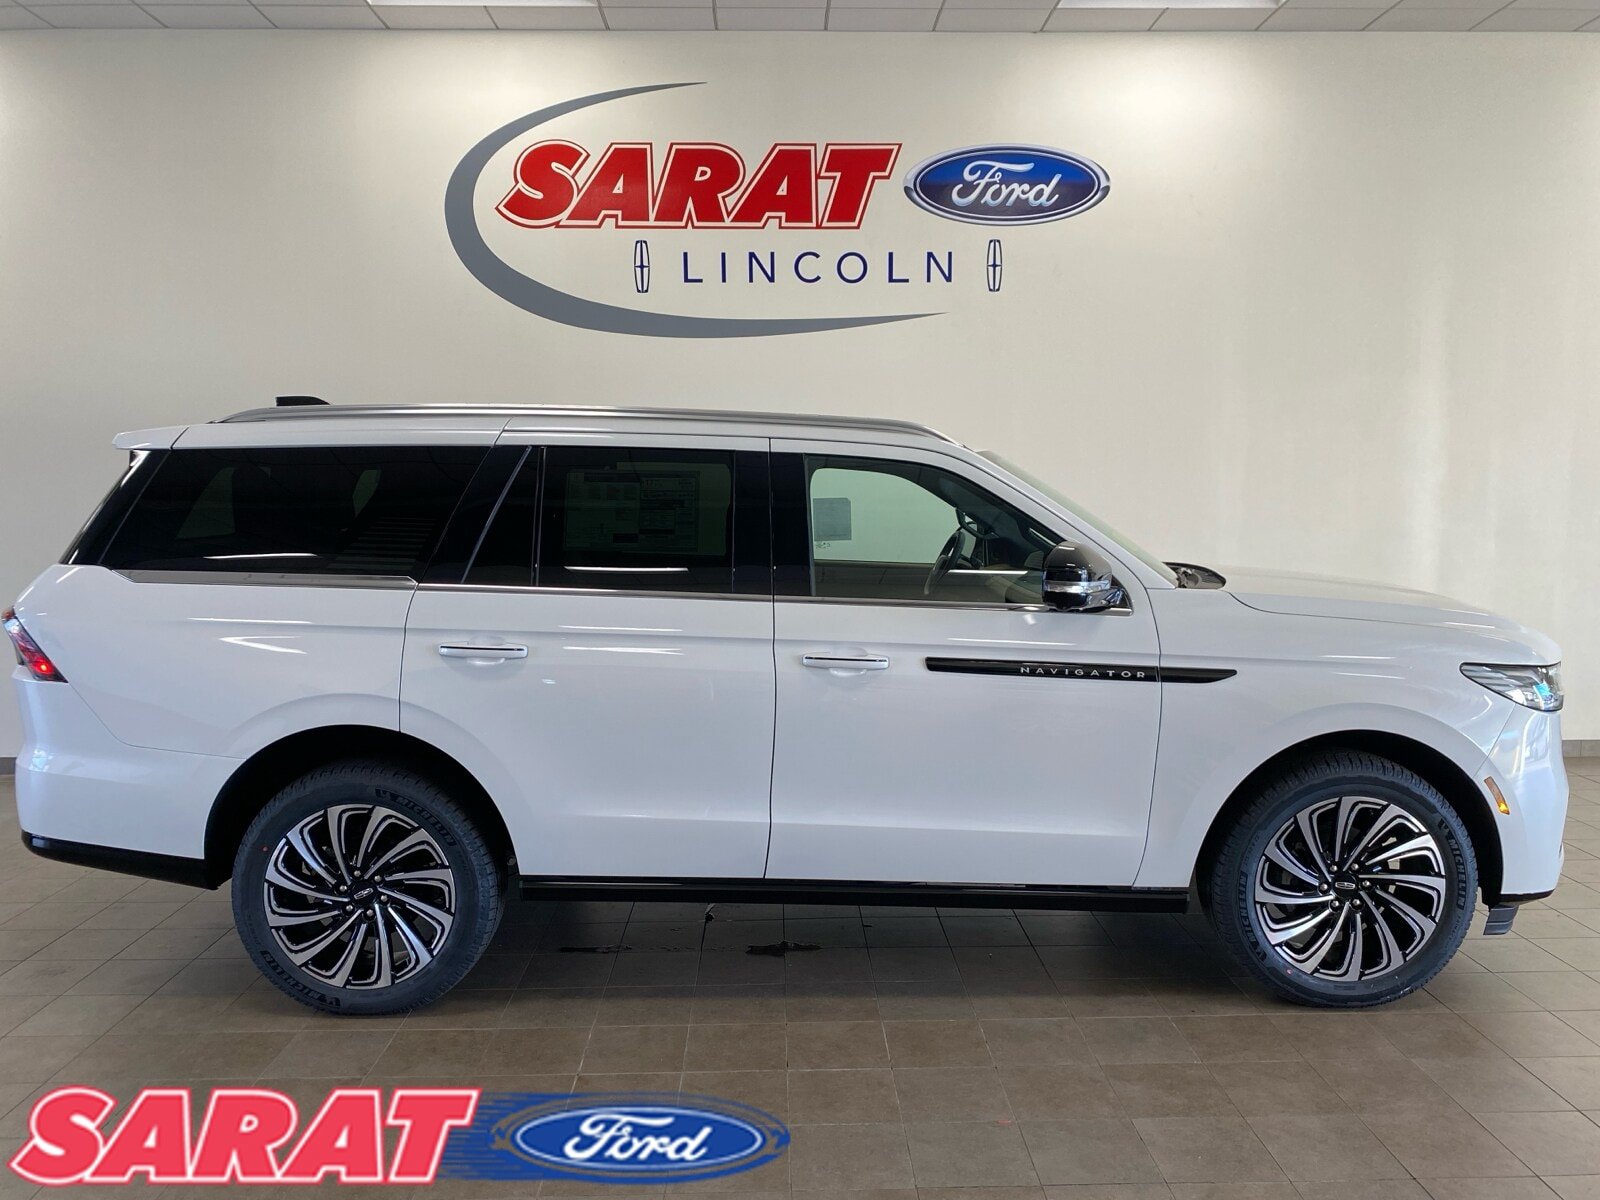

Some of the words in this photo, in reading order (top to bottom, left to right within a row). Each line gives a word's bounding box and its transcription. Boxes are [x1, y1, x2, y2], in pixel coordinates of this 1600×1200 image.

[495, 139, 902, 229] SARAT
[951, 159, 1060, 209] Ford
[682, 251, 953, 284] LINCOLN
[1020, 666, 1145, 678] NAVIGATOR
[1447, 838, 1466, 911] MICHELIN
